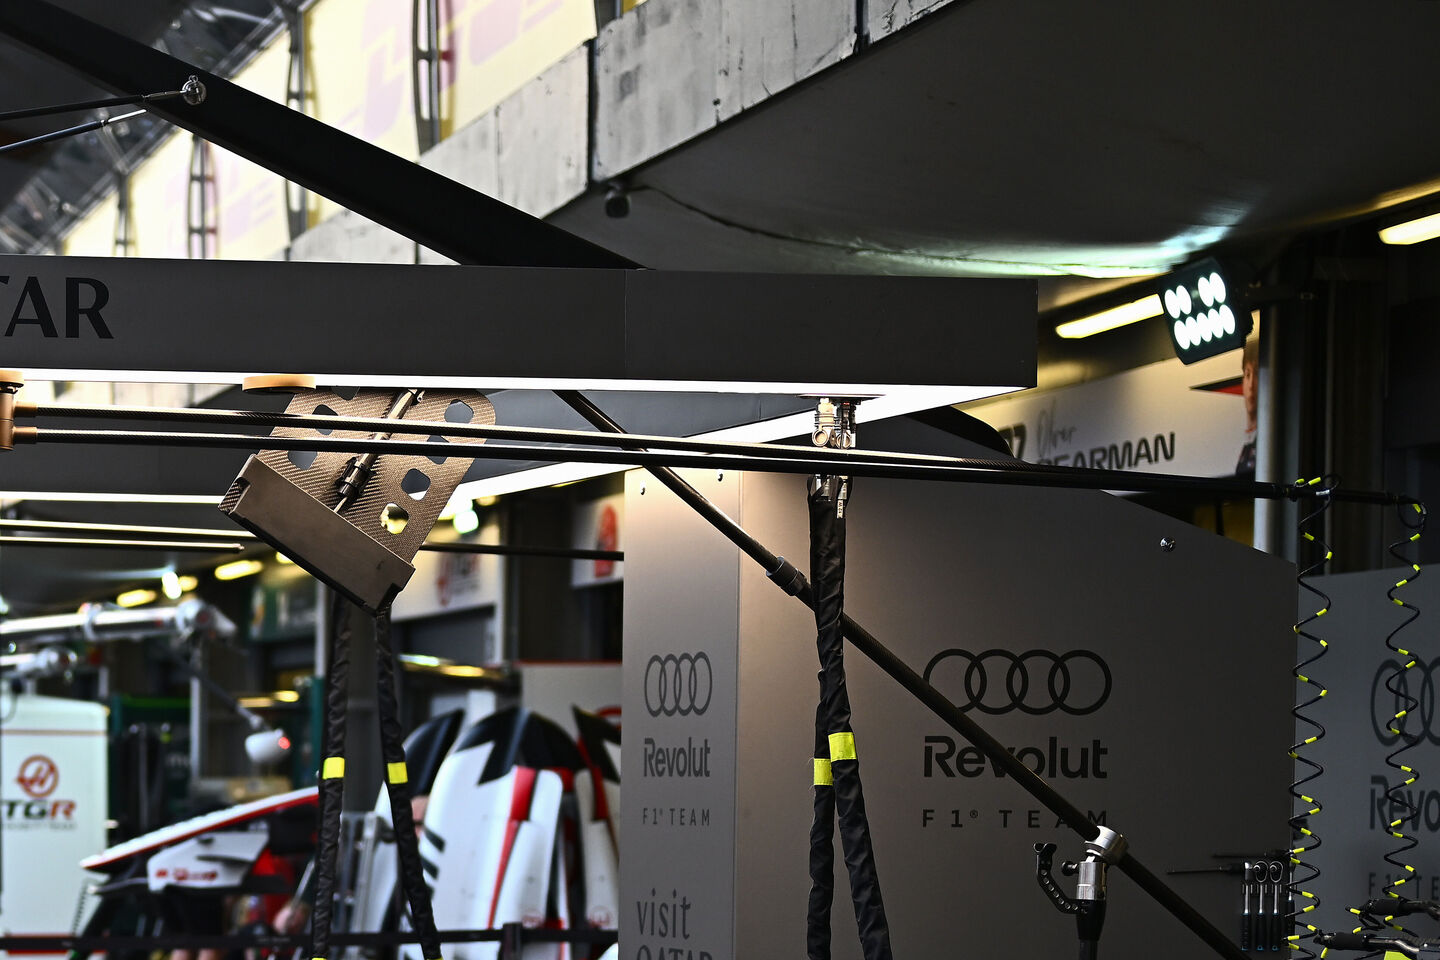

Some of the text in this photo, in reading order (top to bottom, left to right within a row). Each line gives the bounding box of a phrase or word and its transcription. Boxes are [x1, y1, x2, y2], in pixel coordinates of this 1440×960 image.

[998, 423, 1027, 459] 7
[1037, 431, 1175, 470] ARMAN
[644, 736, 710, 777] Revolut
[670, 808, 710, 827] TEAM
[636, 887, 691, 941] visit
